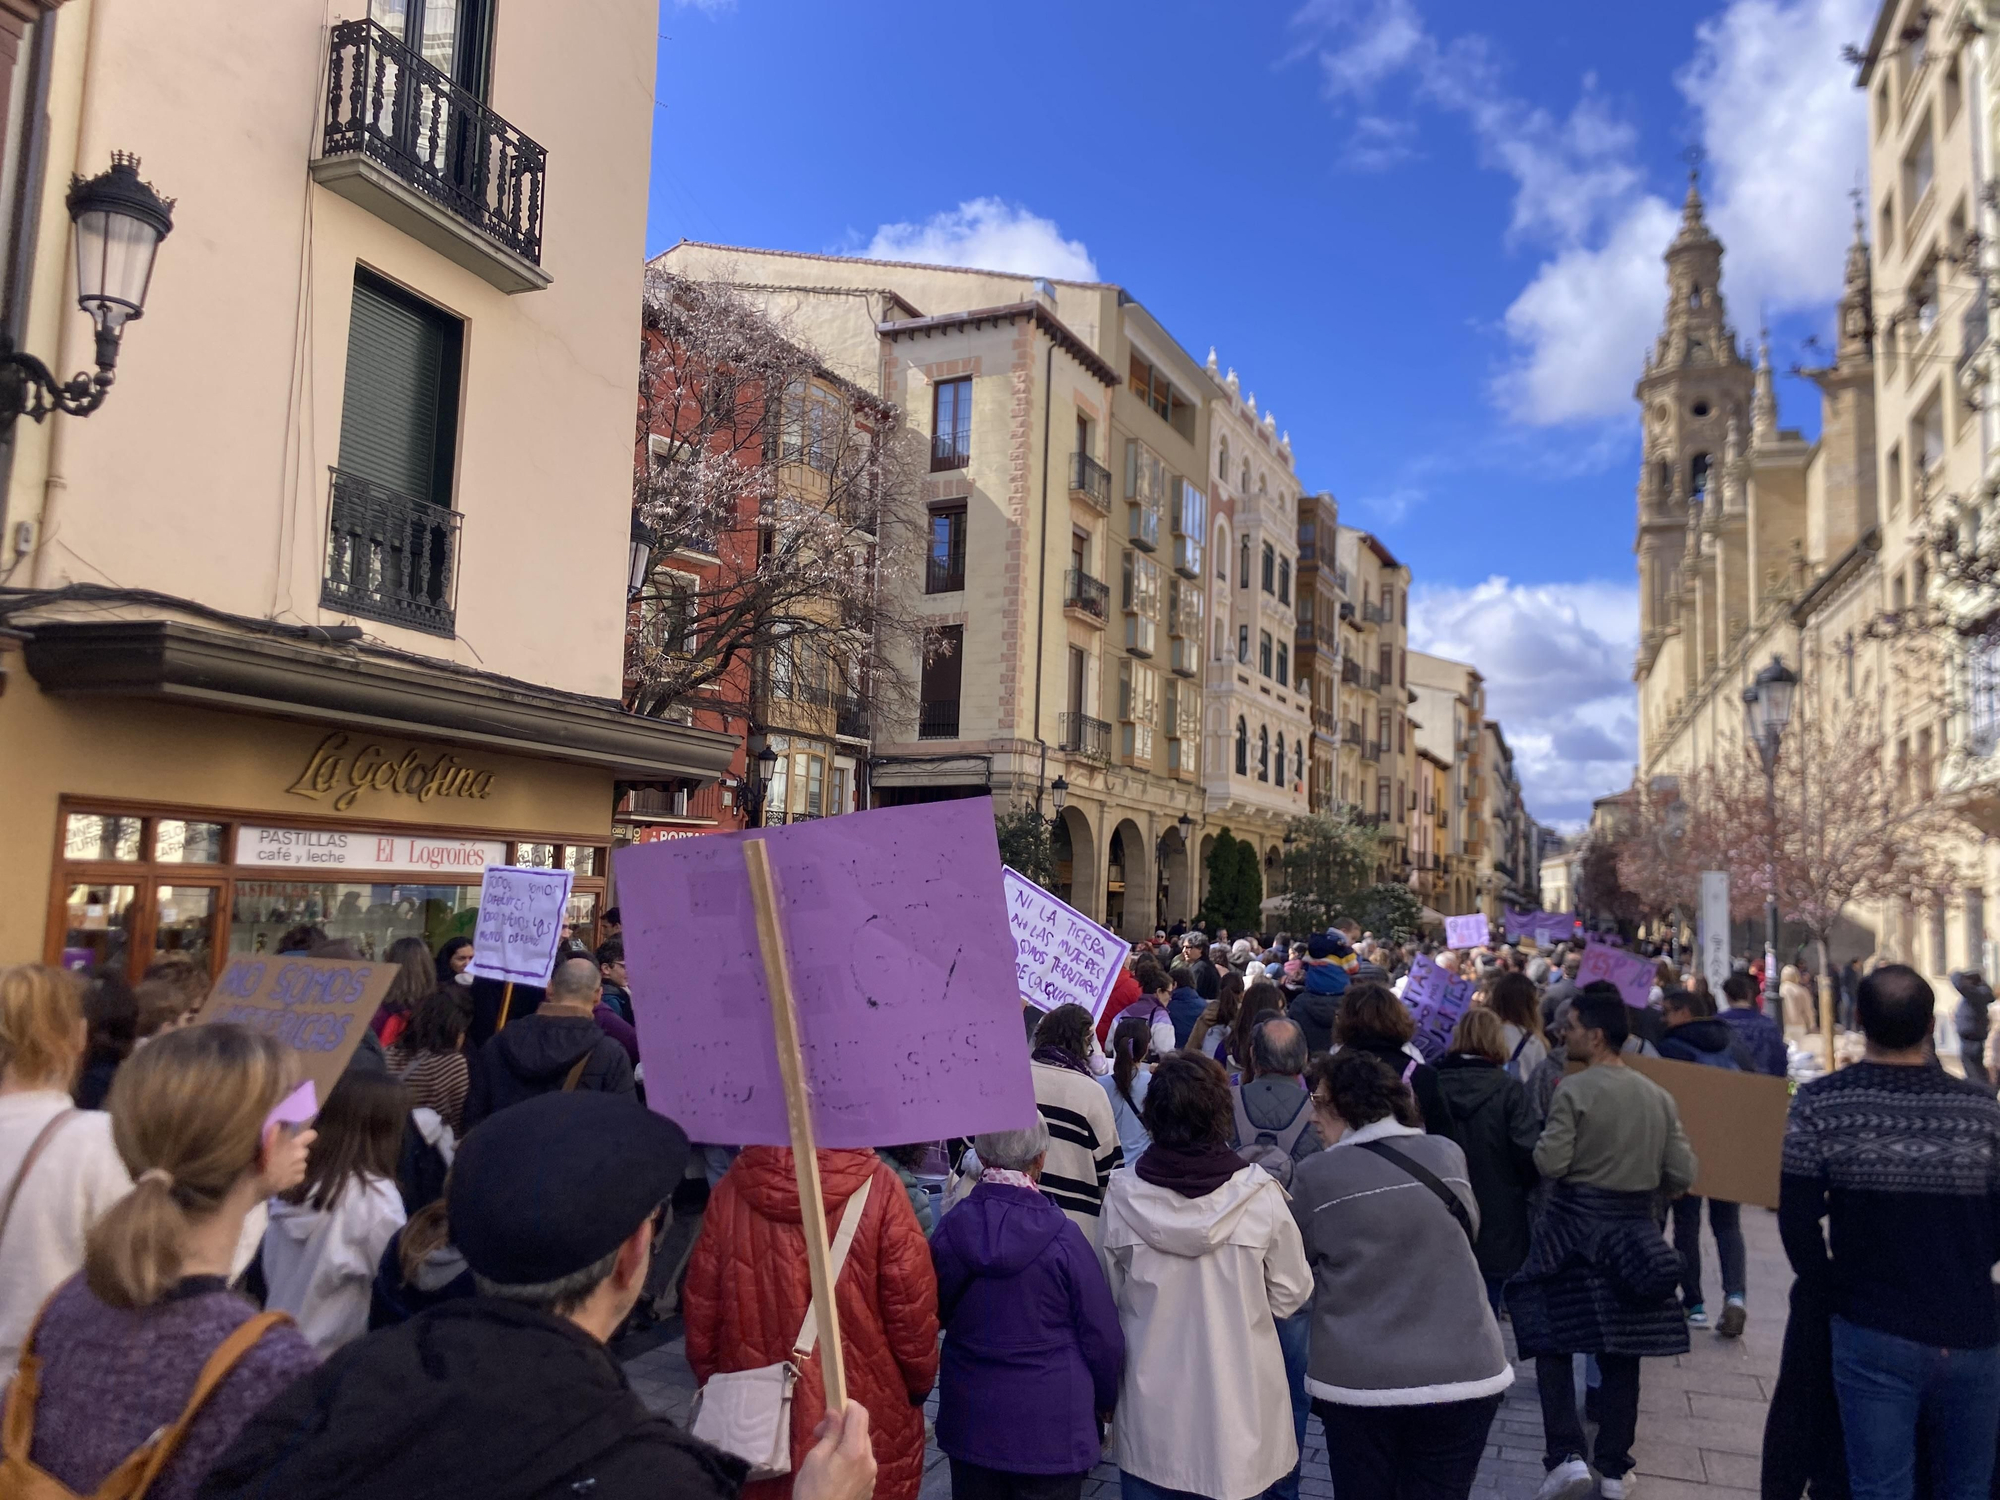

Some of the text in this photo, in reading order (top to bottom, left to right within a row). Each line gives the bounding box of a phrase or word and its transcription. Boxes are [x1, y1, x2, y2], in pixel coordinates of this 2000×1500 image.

[285, 730, 497, 812] La Golosina
[258, 848, 346, 864] café y leche
[259, 830, 348, 848] PASTILLAS
[375, 837, 484, 869] El Logroñés
[1015, 887, 1105, 960] NI LA TIERRA
[1020, 938, 1048, 965] SOMOS
[1029, 925, 1054, 947] LAS
[1058, 939, 1105, 979] MUJERES
[217, 960, 372, 1005] NO SOMOS
